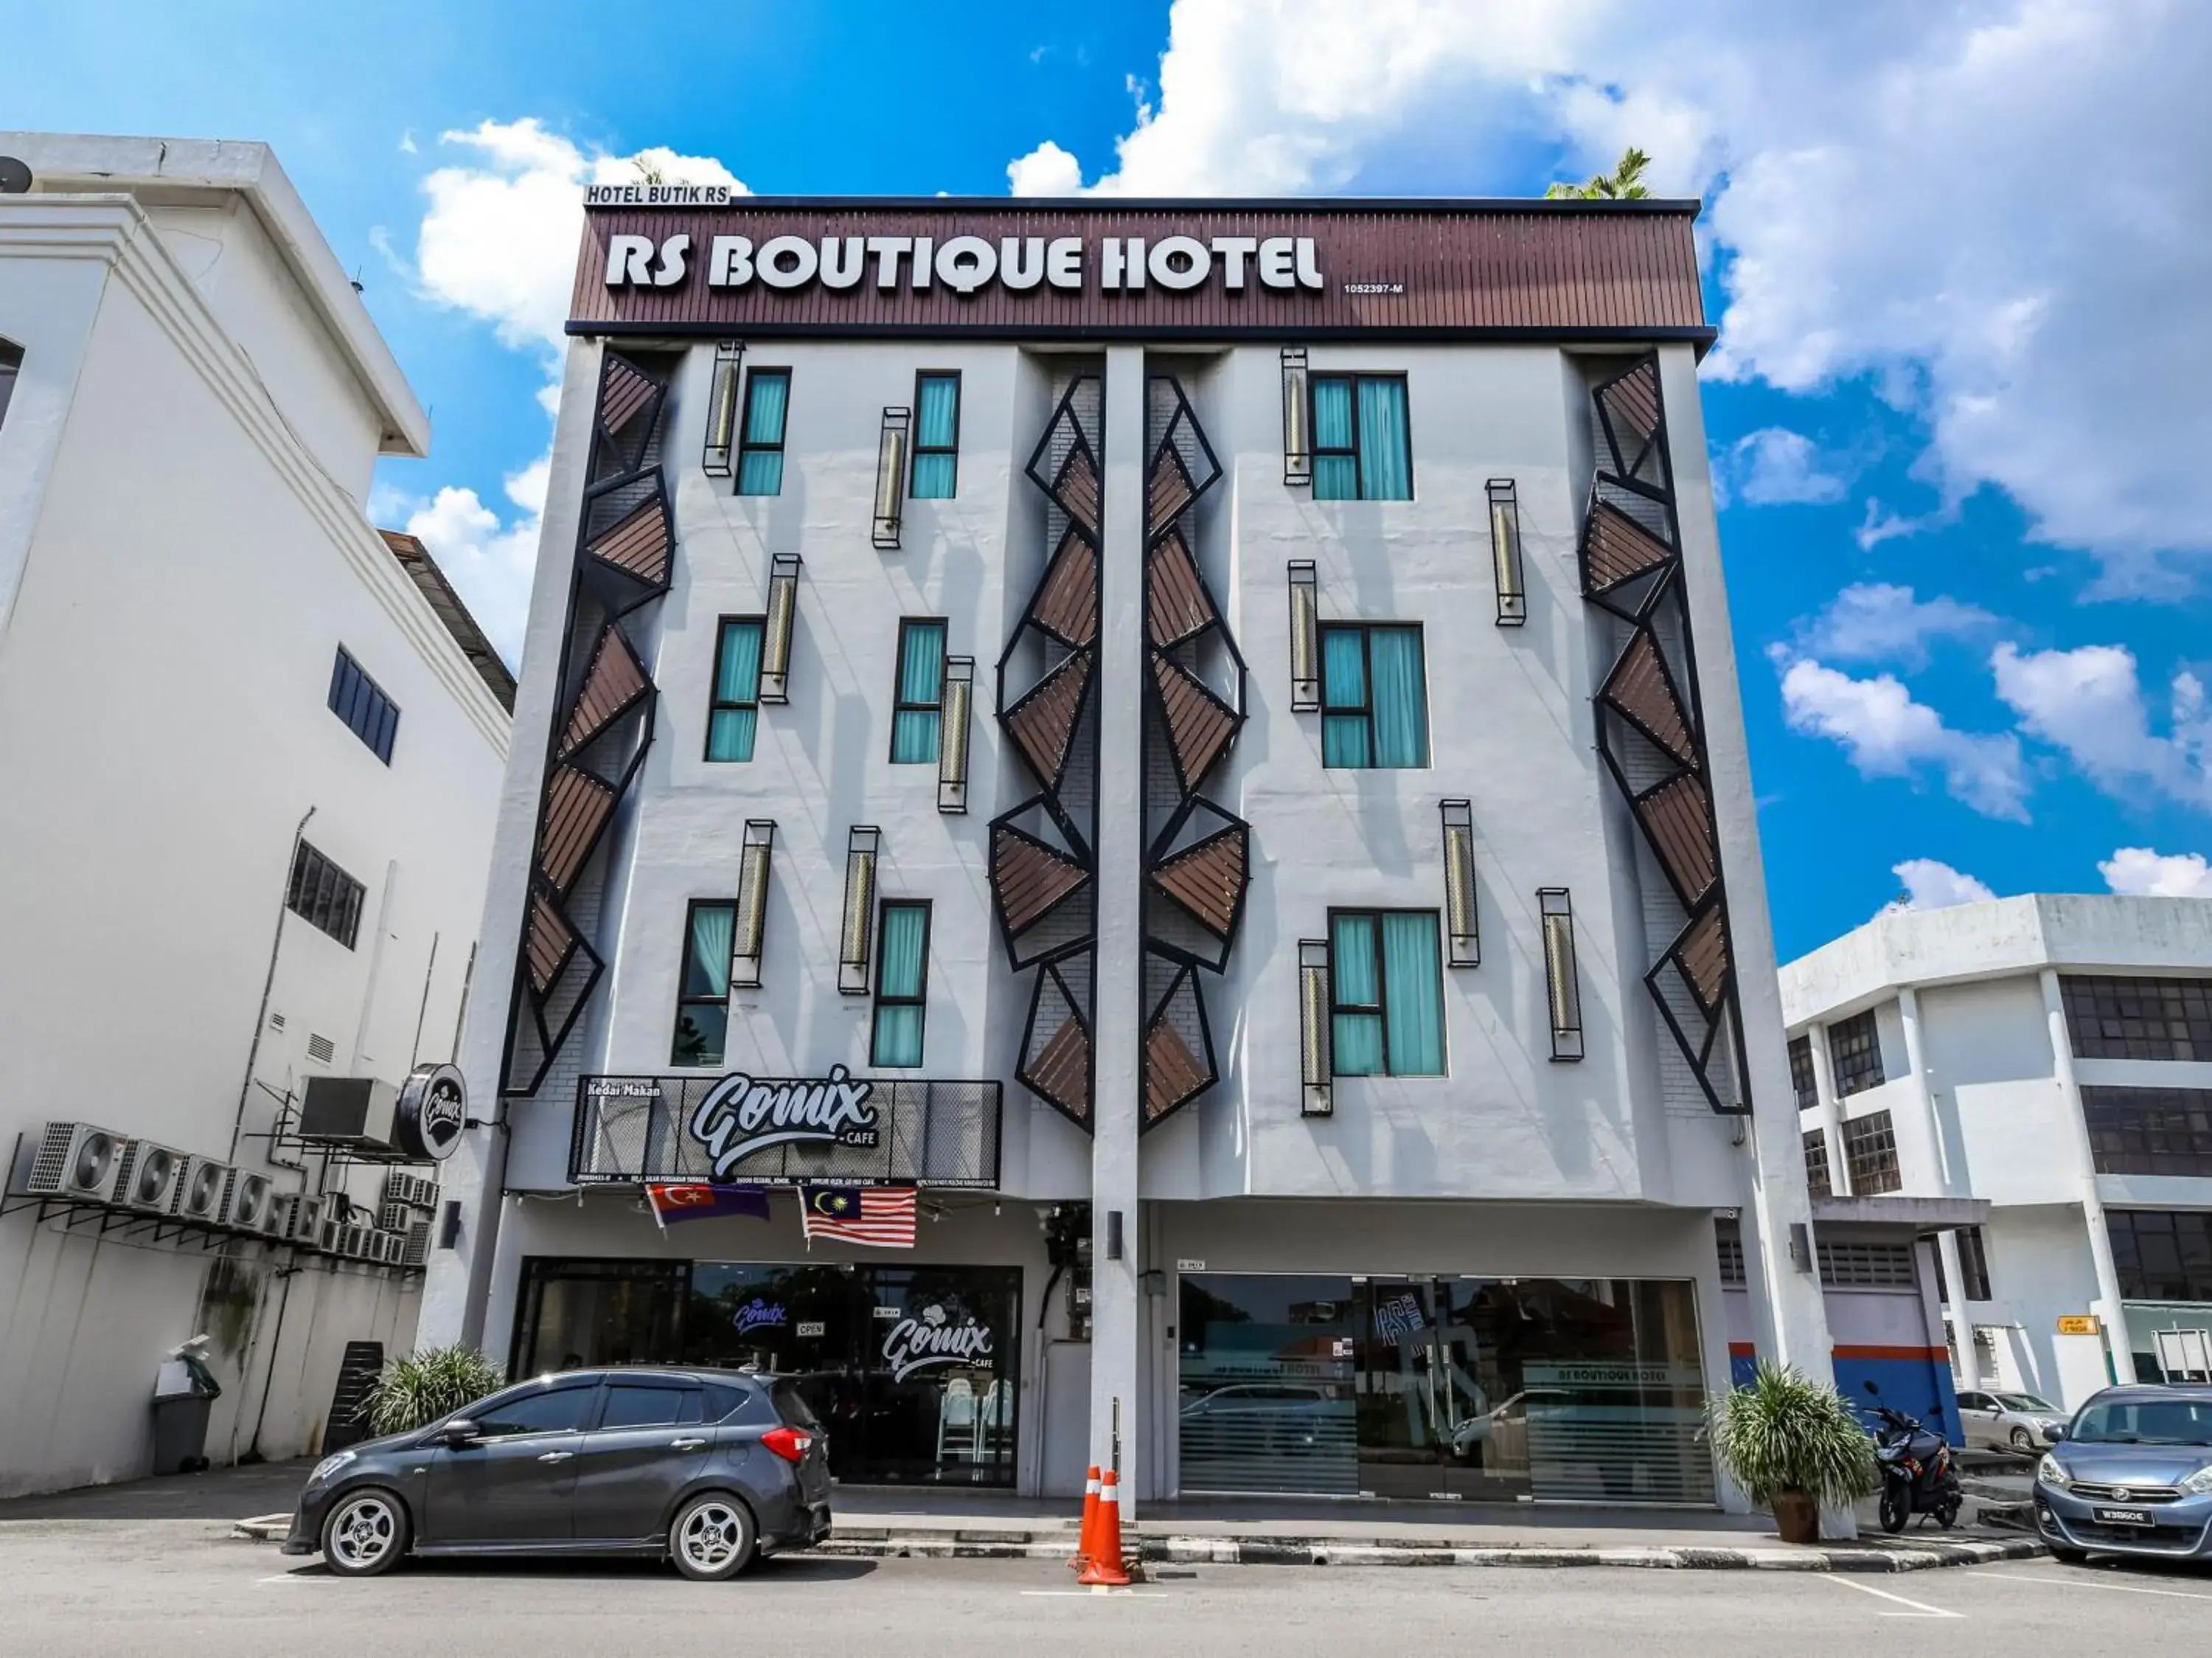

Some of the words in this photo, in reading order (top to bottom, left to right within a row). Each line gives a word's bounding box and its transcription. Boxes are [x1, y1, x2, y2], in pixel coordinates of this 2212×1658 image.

[588, 187, 643, 203] HOTEL
[648, 187, 700, 203] BUTIK
[705, 187, 727, 203] RS
[605, 234, 690, 286] RS
[709, 235, 1082, 293] BOUTIQUE
[1102, 235, 1324, 290] HOTEL
[1344, 283, 1404, 294] 1052397-M
[588, 1083, 619, 1095] Kedai
[623, 1083, 660, 1097] Makan
